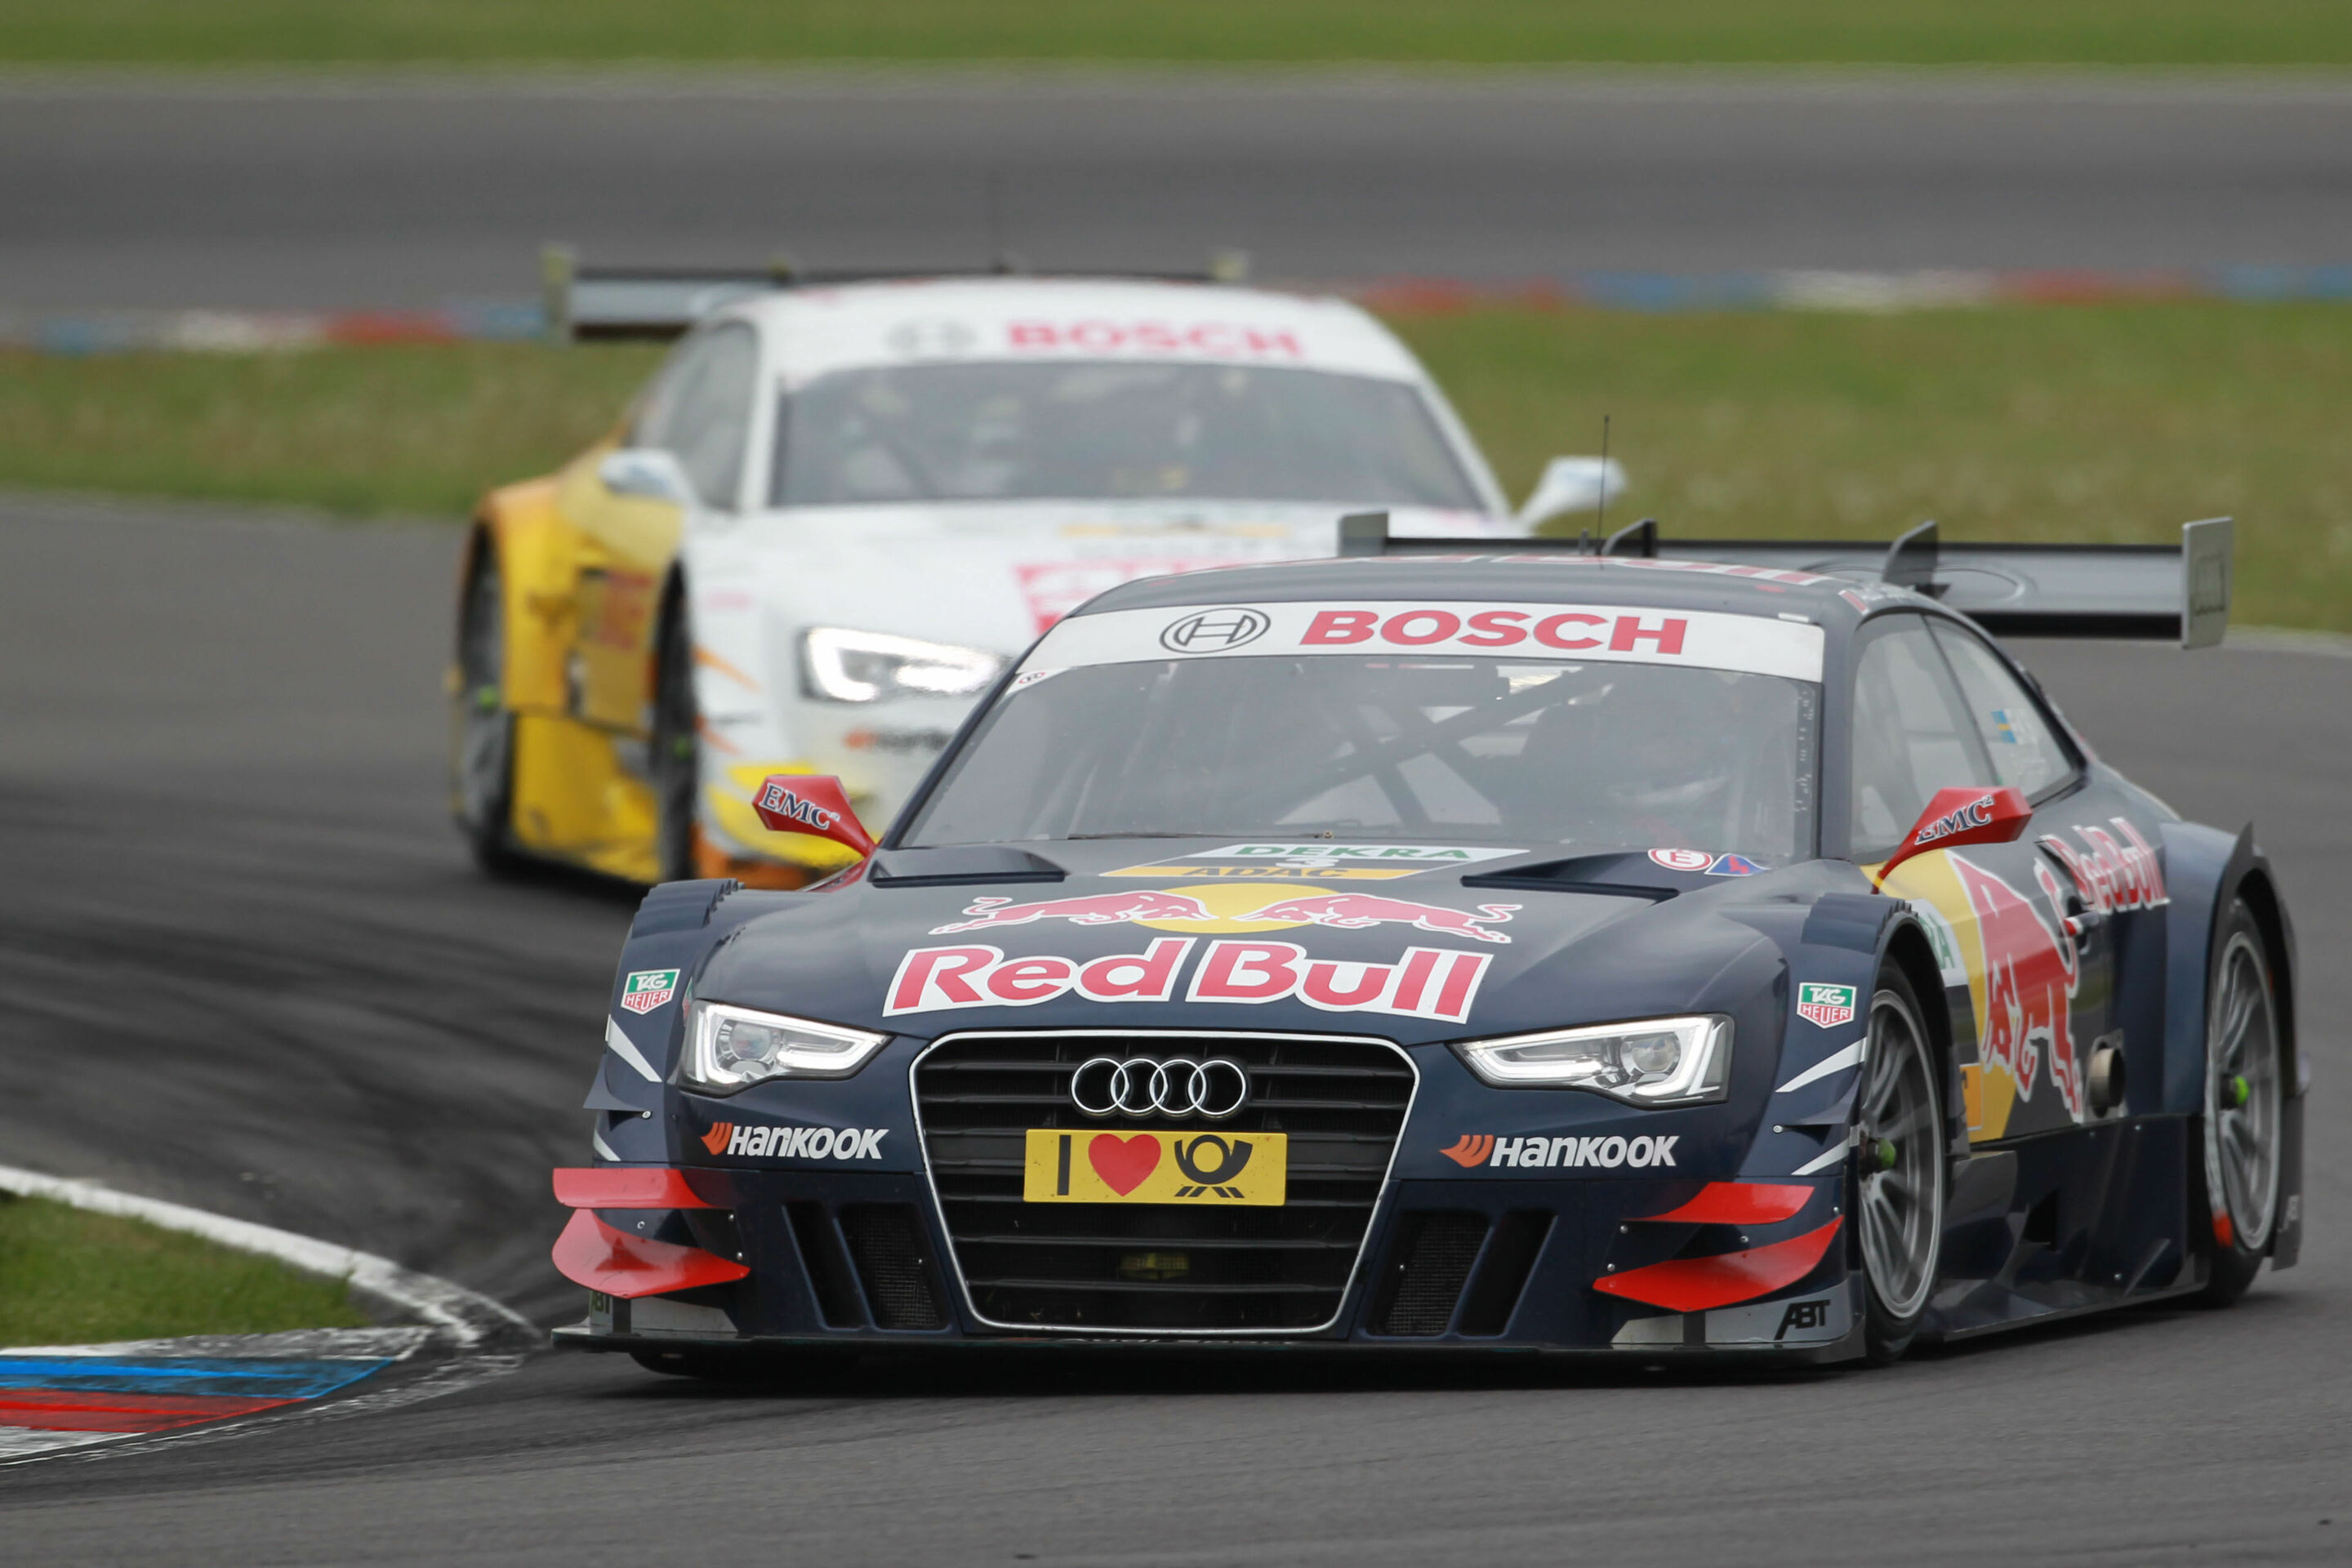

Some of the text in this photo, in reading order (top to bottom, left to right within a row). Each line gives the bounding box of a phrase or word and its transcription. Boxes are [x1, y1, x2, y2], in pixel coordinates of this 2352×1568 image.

[1006, 319, 1304, 358] BOSCH
[1300, 610, 1688, 655] BOSCH
[1235, 846, 1470, 859] DEKRA
[1182, 866, 1348, 878] ADAC
[2084, 817, 2171, 911] Bull
[636, 973, 668, 991] TAG
[884, 938, 1489, 1021] Red Bull
[626, 991, 669, 1012] HEUER
[1809, 987, 1846, 1004] TAG
[1802, 1004, 1850, 1024] HEUER
[1774, 1299, 1831, 1340] ABT
